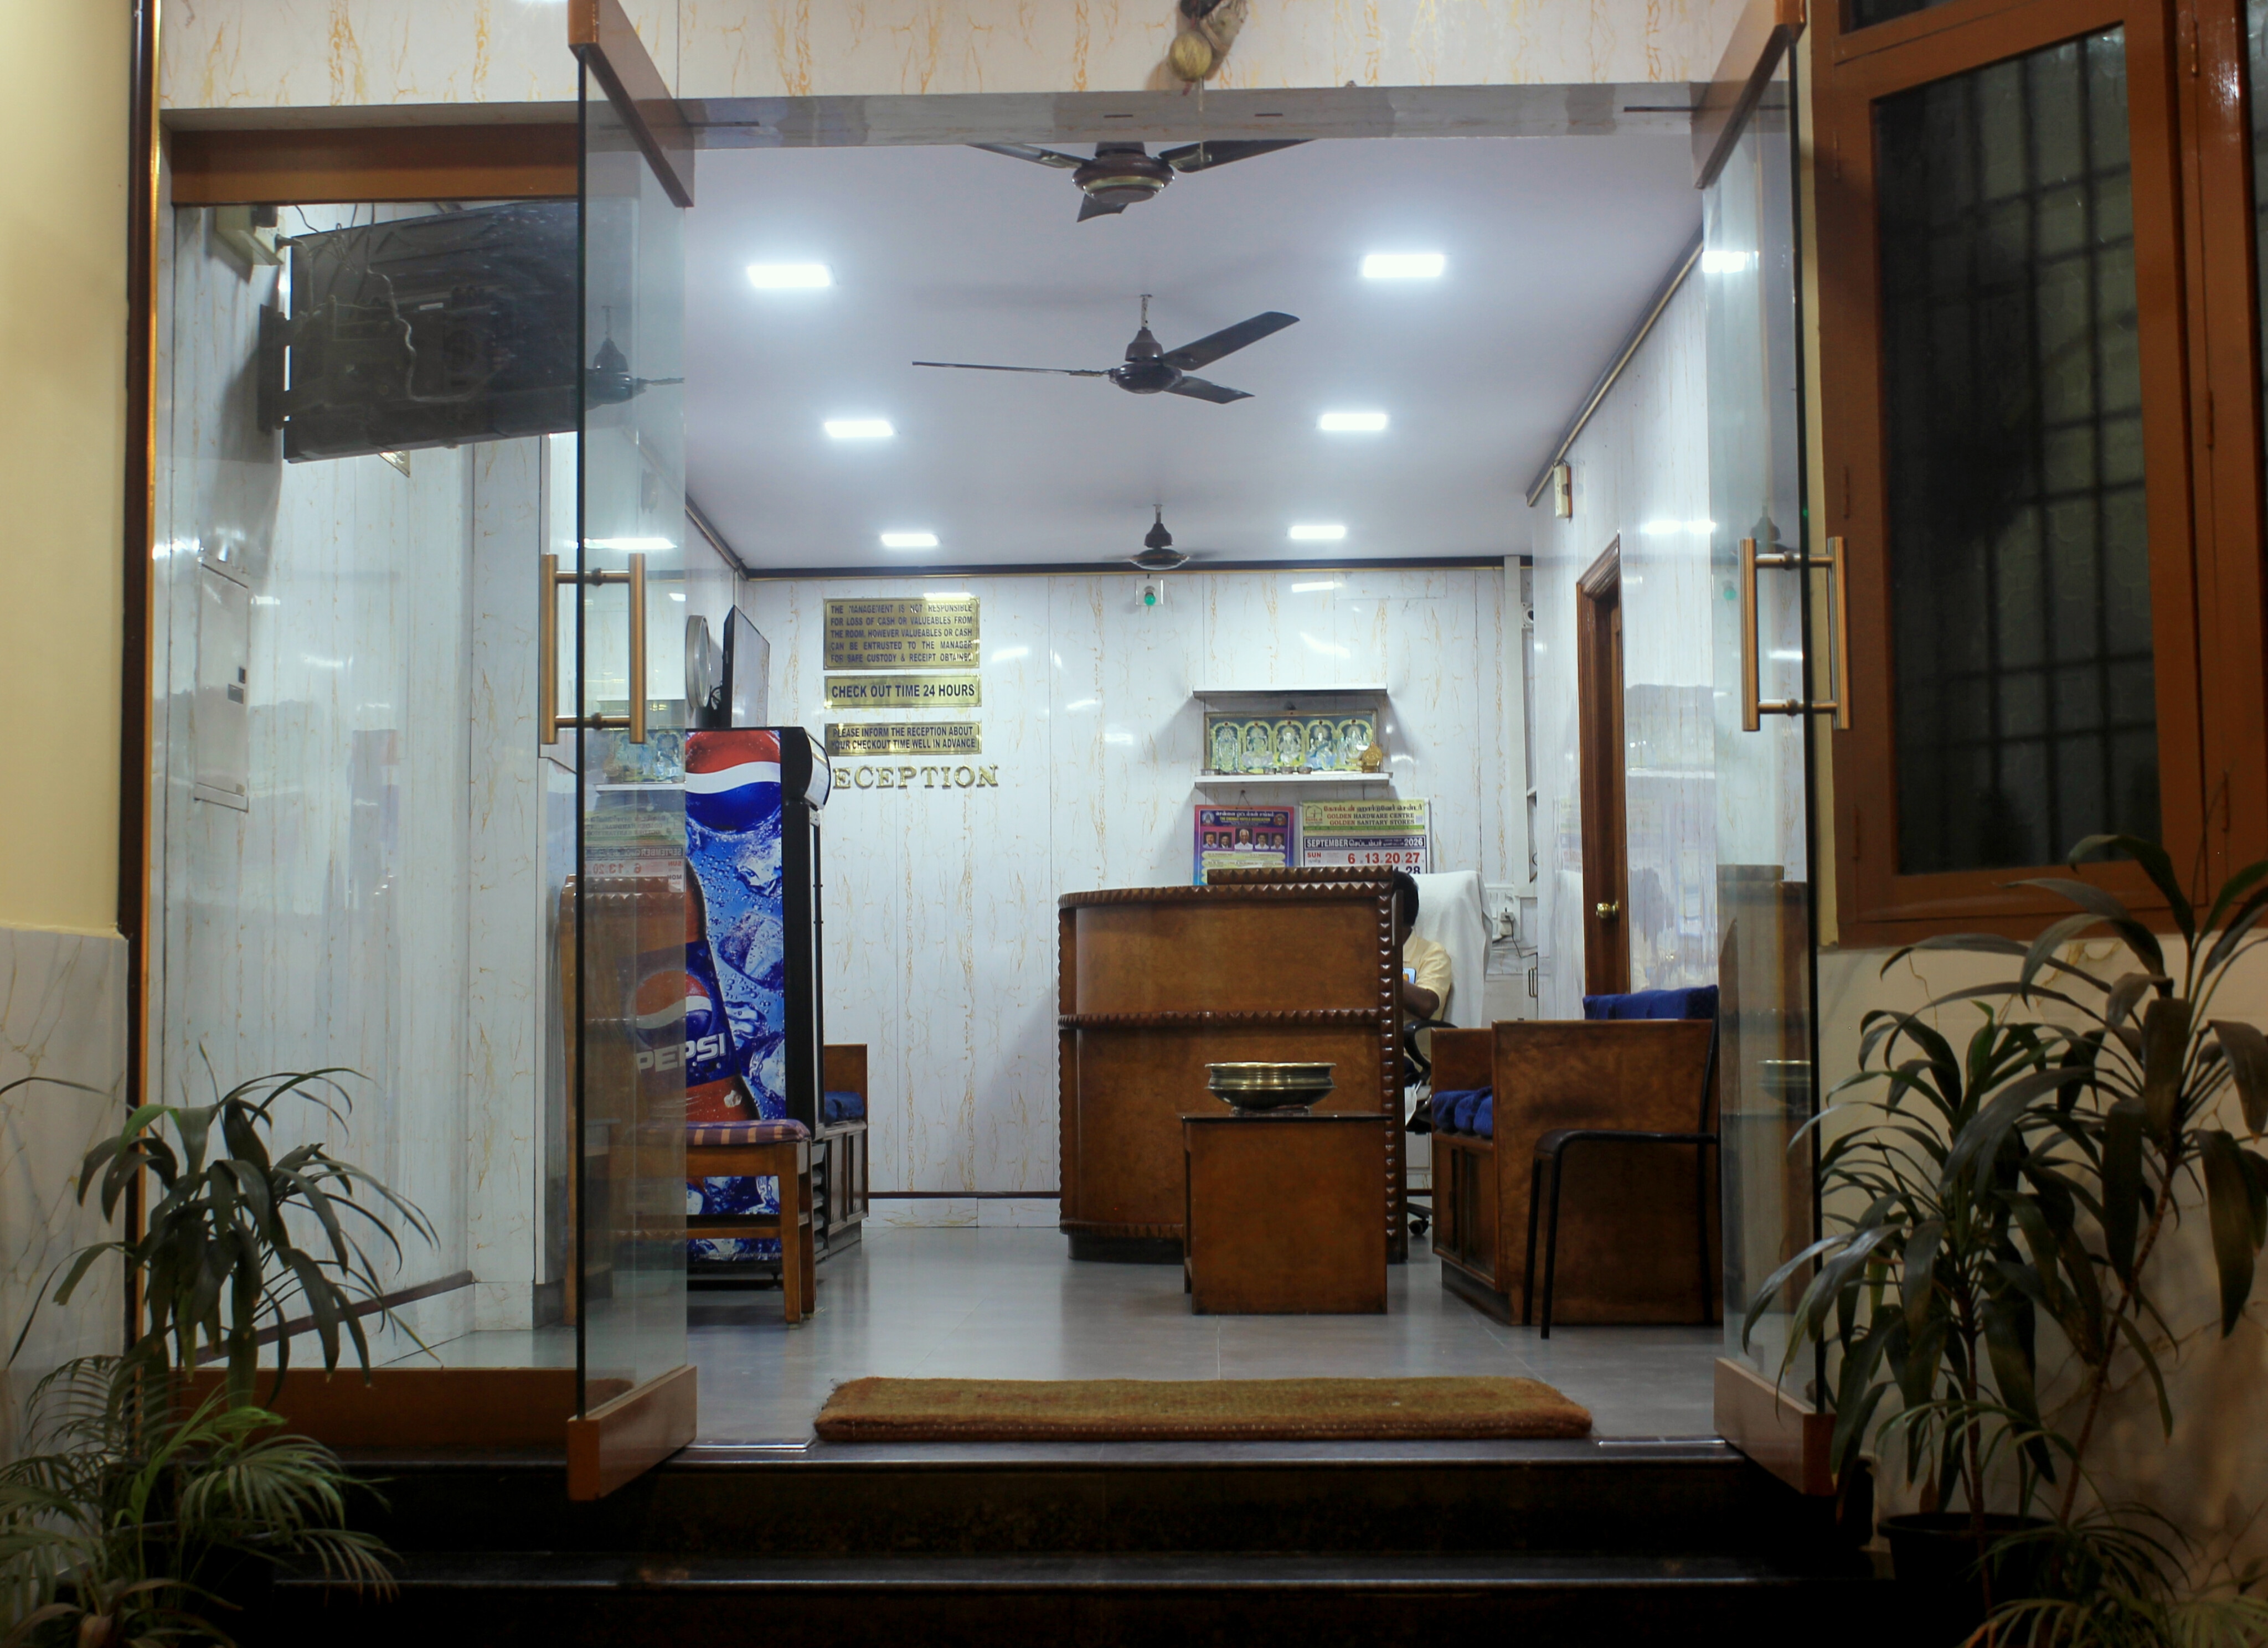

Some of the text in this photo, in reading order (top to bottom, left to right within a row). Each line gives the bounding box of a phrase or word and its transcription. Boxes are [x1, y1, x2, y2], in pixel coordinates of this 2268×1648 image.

[849, 605, 894, 613] MANAGEMENT
[911, 605, 922, 613] NOT
[928, 603, 972, 612] RESPONSIBLE
[847, 617, 863, 626] LOSS
[866, 617, 874, 626] OF
[878, 617, 895, 626] CASH
[898, 617, 907, 625] OR
[910, 616, 951, 624] VALUEABLES
[831, 630, 843, 638] THE
[868, 629, 899, 638] HOWEVER
[902, 629, 942, 637] VALUEABLES
[944, 628, 952, 637] OR
[831, 642, 844, 650] CAN
[864, 641, 902, 650] ENTRUSTED
[908, 641, 916, 649] TO
[922, 640, 934, 649] THE
[941, 640, 972, 649] MANAGER
[847, 654, 863, 662] SAFE
[867, 653, 896, 662] CUSTODY
[901, 653, 905, 662] &
[909, 653, 936, 662] RECEIPT
[940, 653, 973, 662] OBTAINED
[832, 684, 975, 698] CHECK OUT TIME 24 HOURS
[833, 726, 973, 737] PLEASE INFORM THE RECEPTION ABOUT
[831, 738, 975, 750] YOUR CHECKOUT TIME WELL IN ADVANCE
[832, 764, 999, 789] ECEPTION
[1307, 839, 1348, 848] SEPTEMBER
[1404, 838, 1423, 846] 2026
[1348, 853, 1355, 864] 6
[1365, 853, 1379, 864] 13
[1385, 853, 1400, 864] 20
[1405, 852, 1420, 864] 27
[636, 1032, 726, 1073] PEPSI
